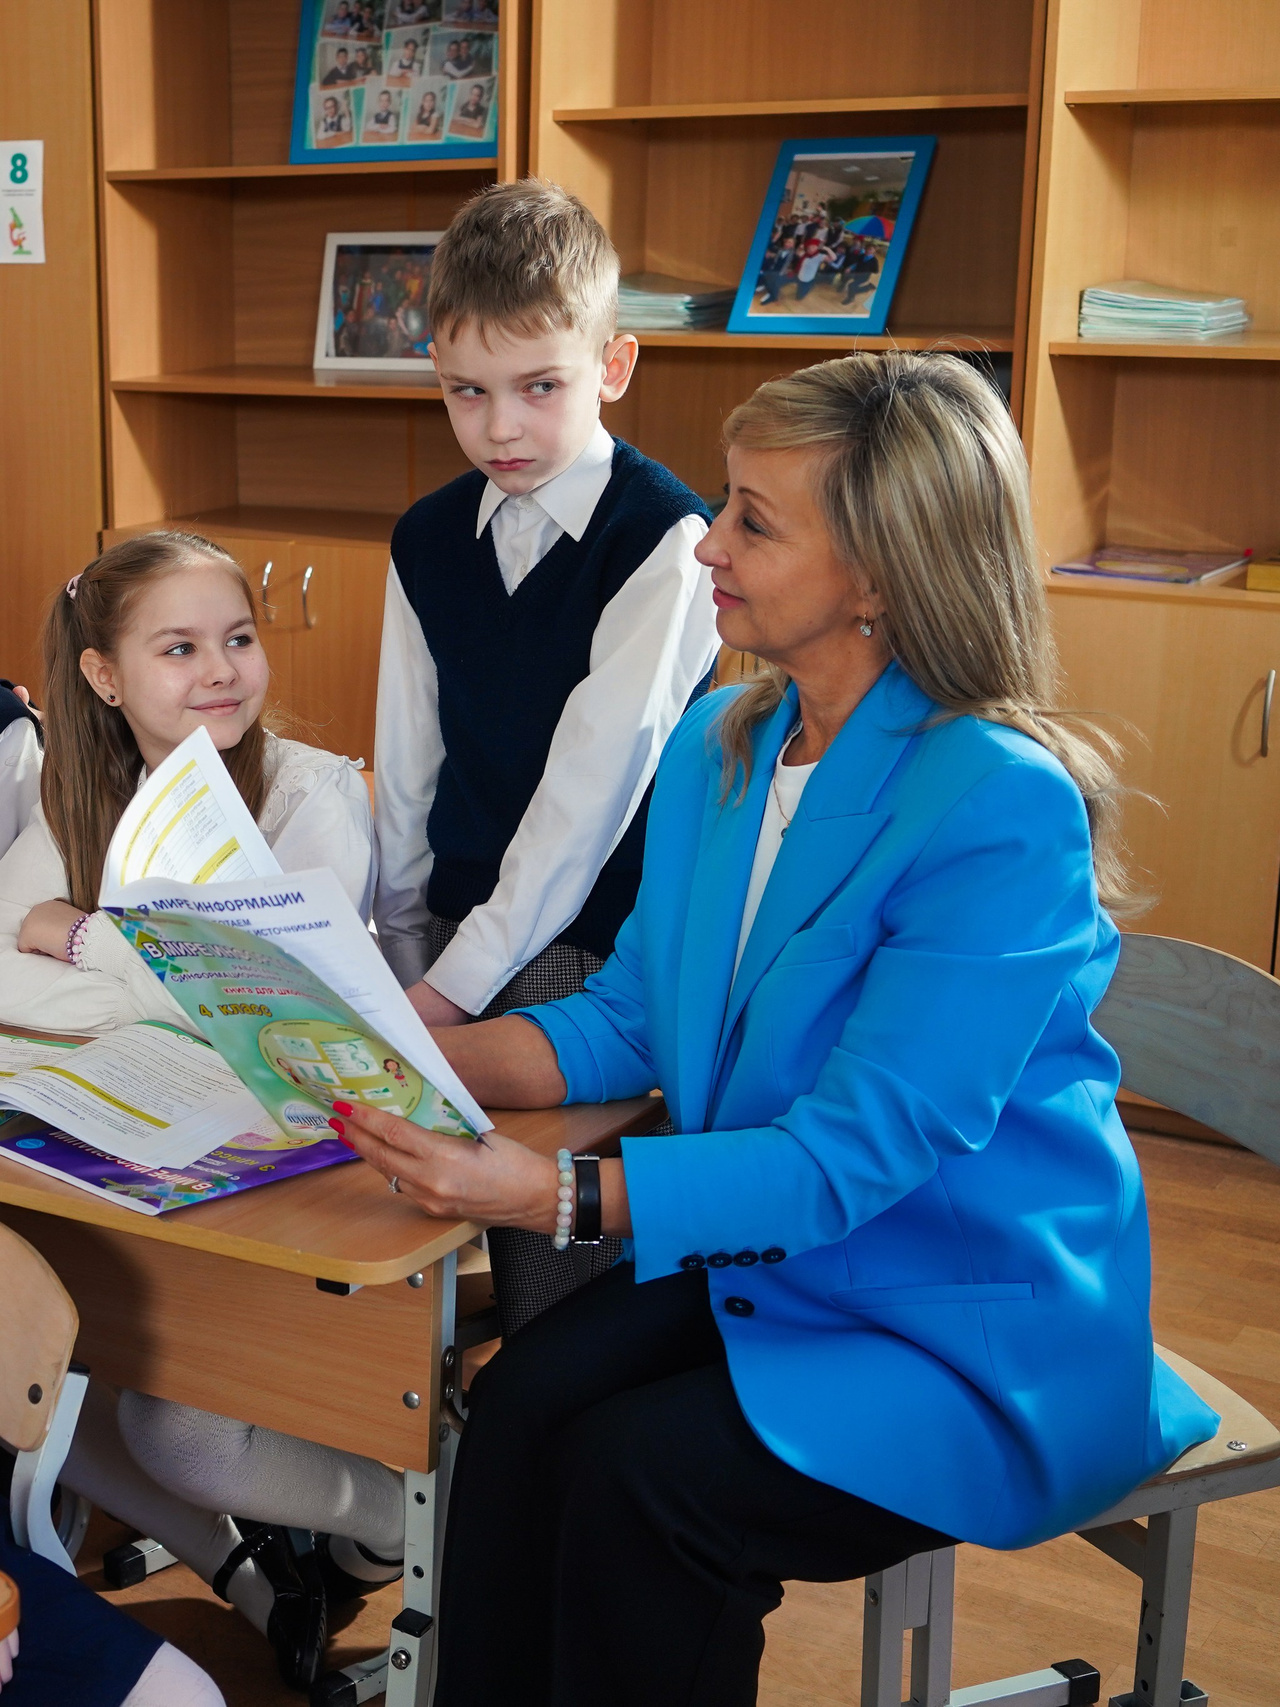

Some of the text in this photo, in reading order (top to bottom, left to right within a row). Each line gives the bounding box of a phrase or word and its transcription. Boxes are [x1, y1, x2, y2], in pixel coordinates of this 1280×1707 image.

[10, 153, 28, 184] 8
[152, 898, 194, 911] МИРЕ
[195, 891, 305, 914] ИНФОРМАЦИИ
[254, 920, 332, 937] ИСТОЧНИКАМИ
[141, 941, 213, 959] В МИРЕ
[223, 986, 253, 995] книга
[254, 986, 275, 996] для
[199, 1002, 273, 1018] 4 класс
[259, 1164, 275, 1172] 3
